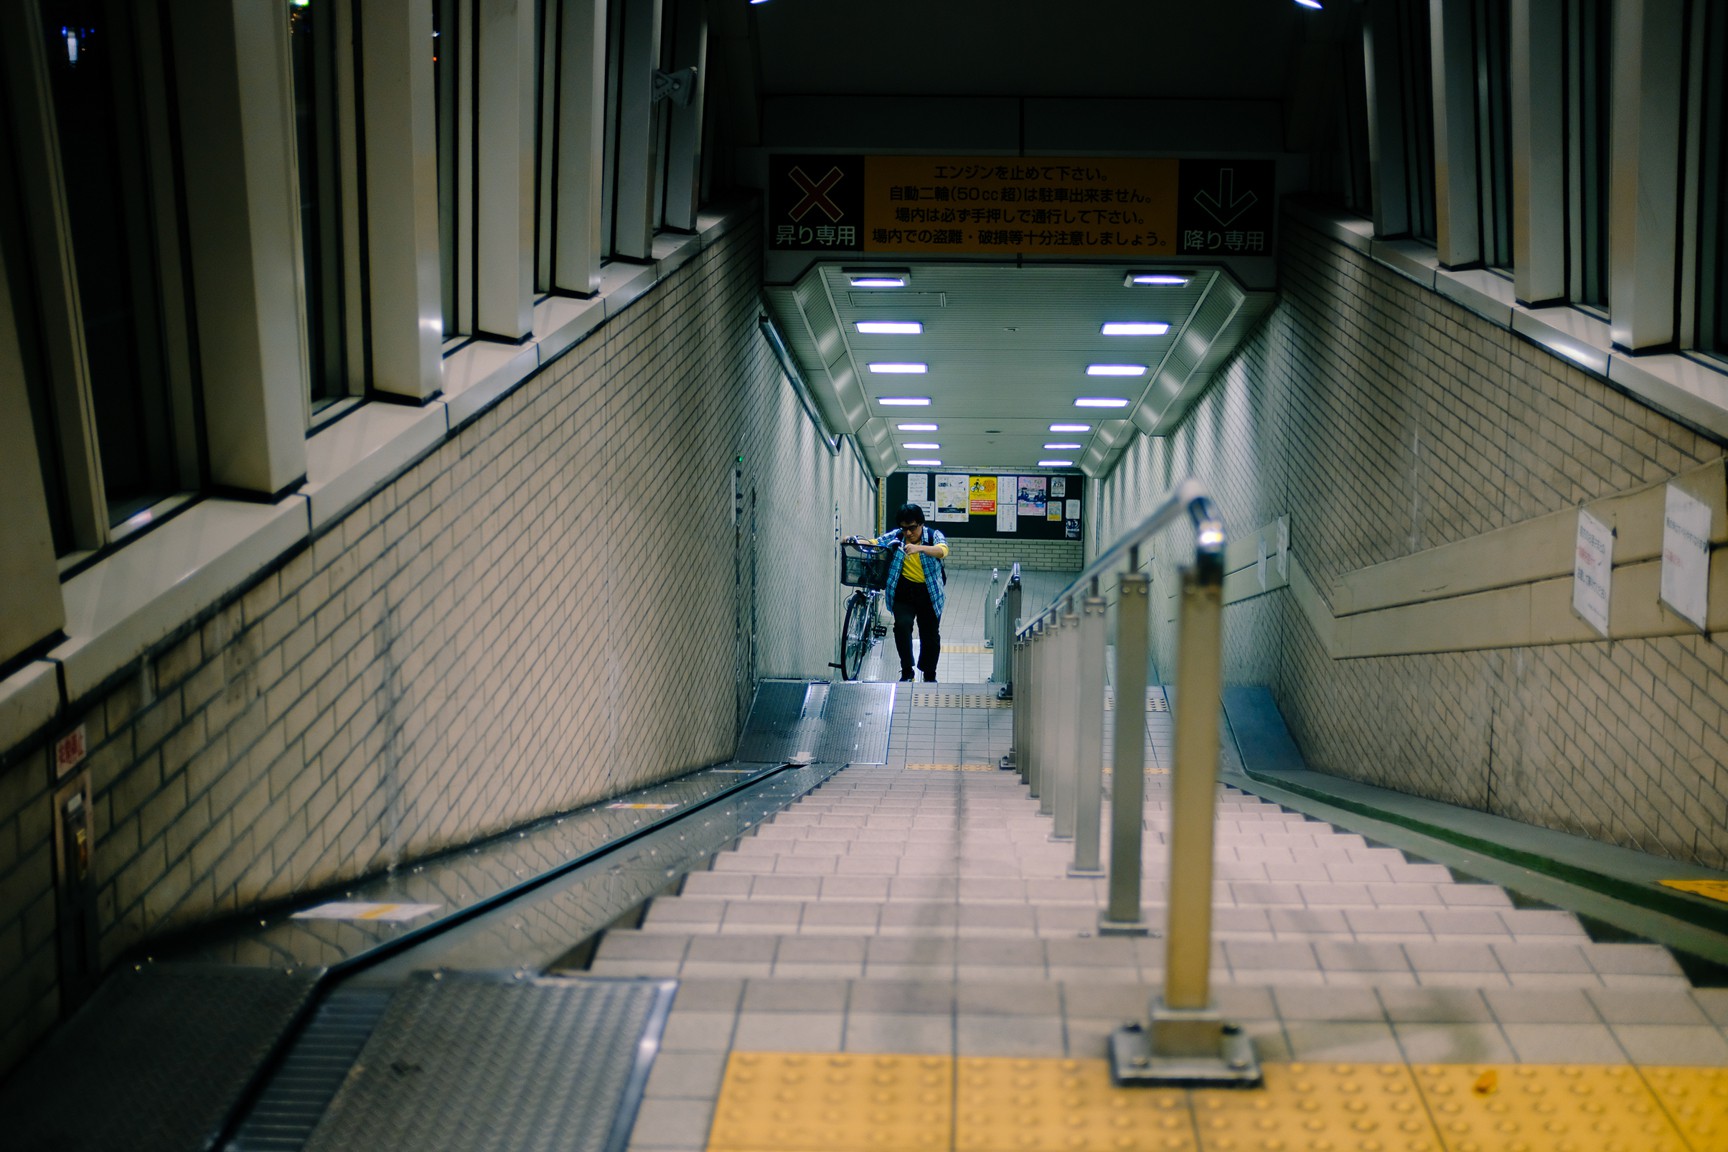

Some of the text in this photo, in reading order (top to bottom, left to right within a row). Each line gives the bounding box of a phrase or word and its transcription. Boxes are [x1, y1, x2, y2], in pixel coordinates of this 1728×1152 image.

[934, 165, 1107, 182] エンジンを止めて下さい。
[896, 207, 1144, 225] 場内は必ず手押しで通行して下さい。
[776, 225, 856, 246] 昇り専用
[872, 228, 1167, 246] 場内での盗難・破損等十分注意しましょう。
[1184, 230, 1265, 251] 降り専用
